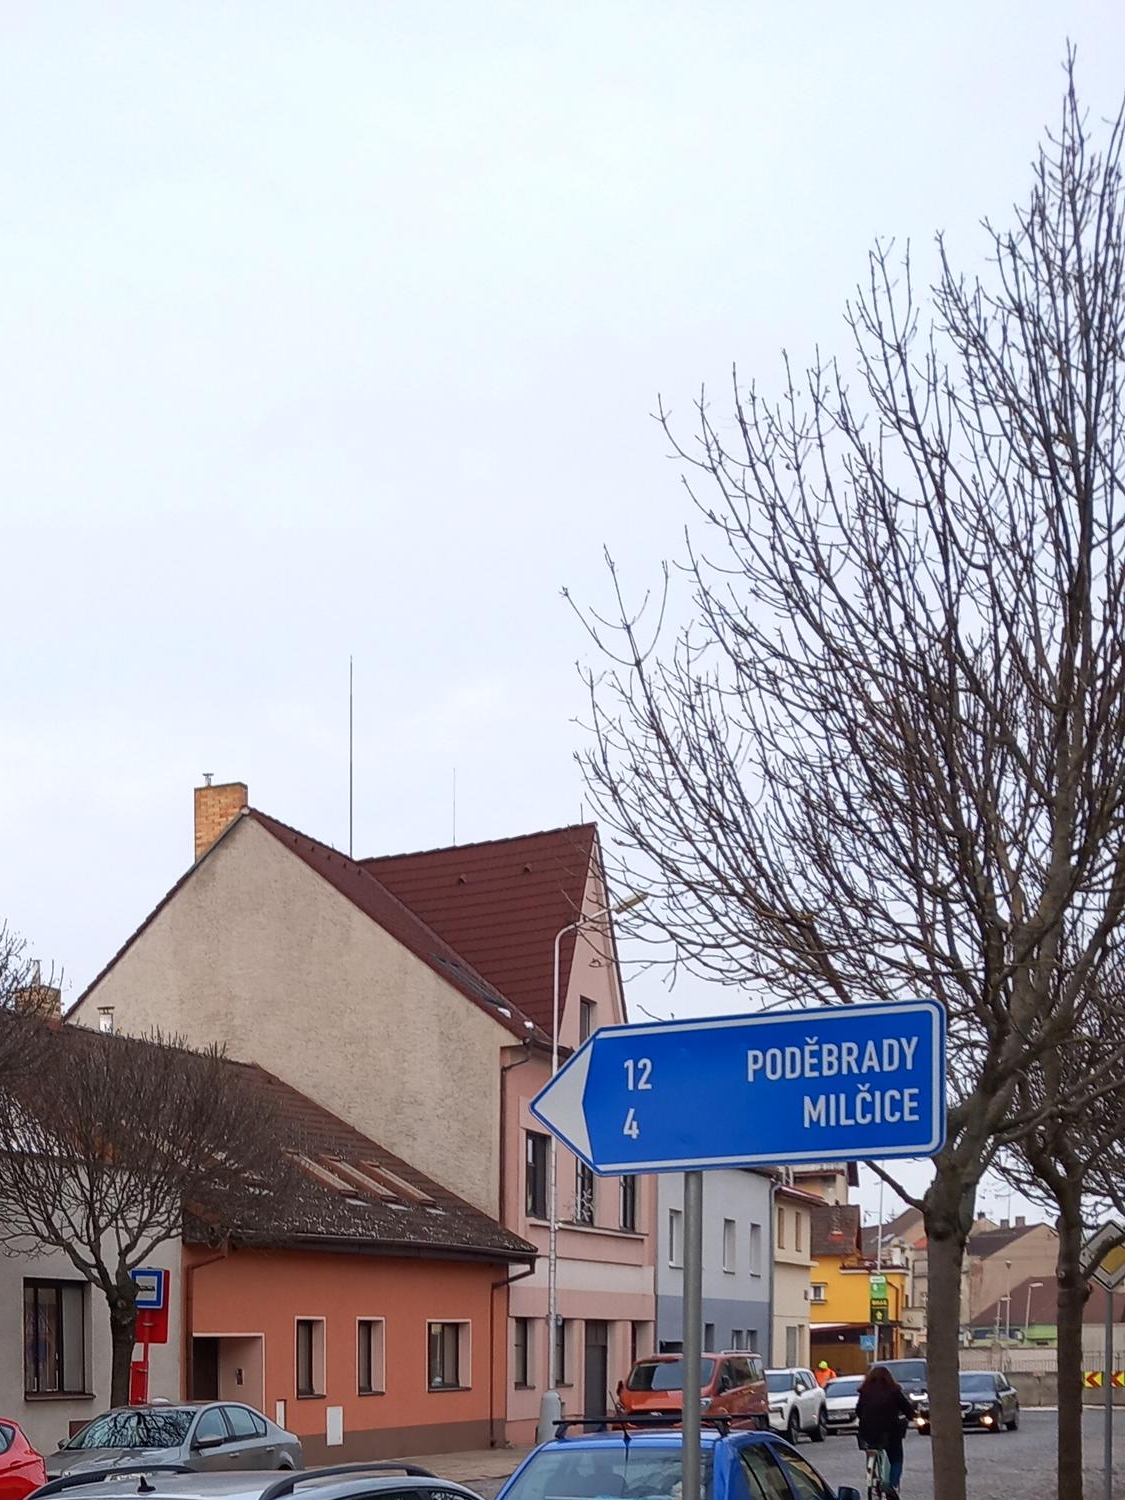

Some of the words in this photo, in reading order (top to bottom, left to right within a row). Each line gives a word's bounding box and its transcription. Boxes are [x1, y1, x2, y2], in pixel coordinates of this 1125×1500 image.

[622, 1056, 653, 1092] 12
[746, 1034, 920, 1083] PODĚBRADY
[621, 1106, 641, 1140] 4
[801, 1081, 921, 1129] MILČICE
